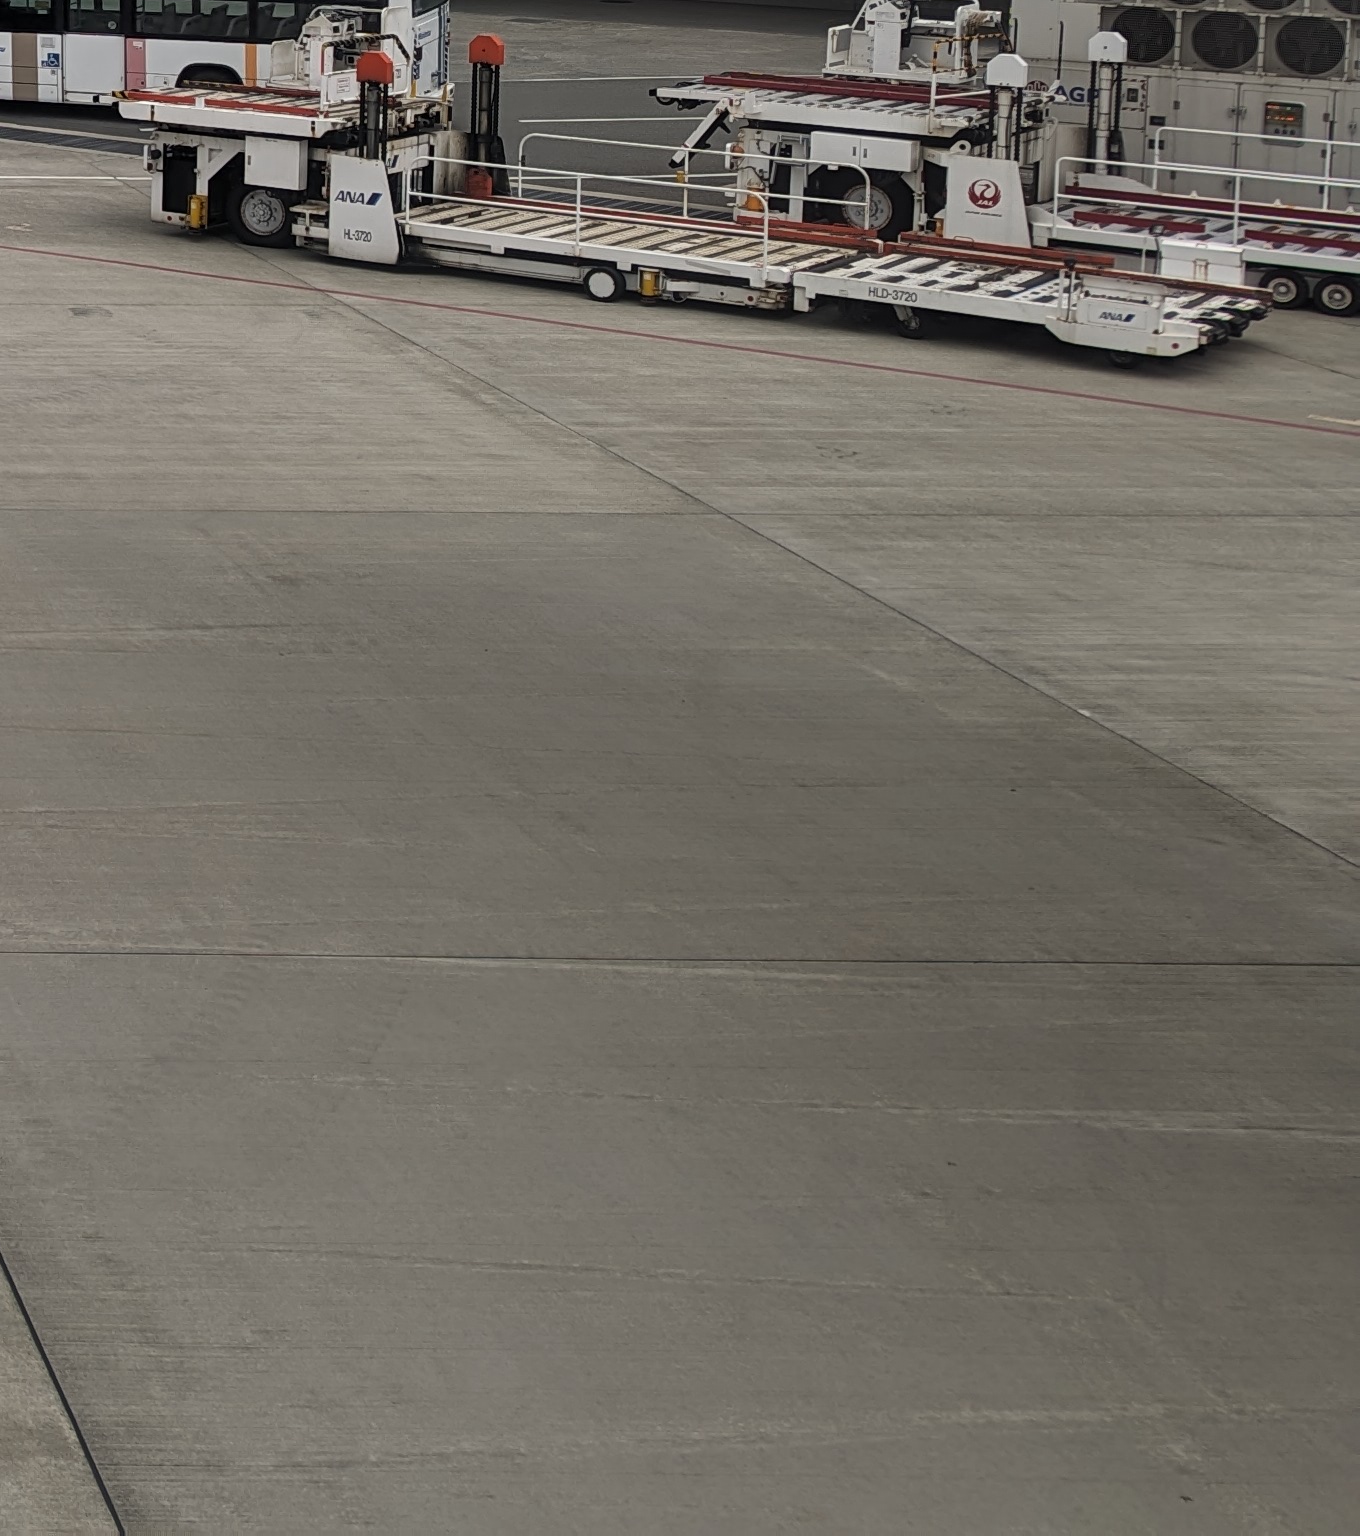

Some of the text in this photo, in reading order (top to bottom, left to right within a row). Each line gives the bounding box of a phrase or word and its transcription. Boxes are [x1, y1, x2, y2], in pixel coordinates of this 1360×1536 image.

[334, 190, 366, 205] ANA
[976, 199, 994, 207] JAL
[343, 228, 373, 243] HL-3720
[868, 286, 918, 304] HLD-3720
[1098, 311, 1125, 322] ANA
